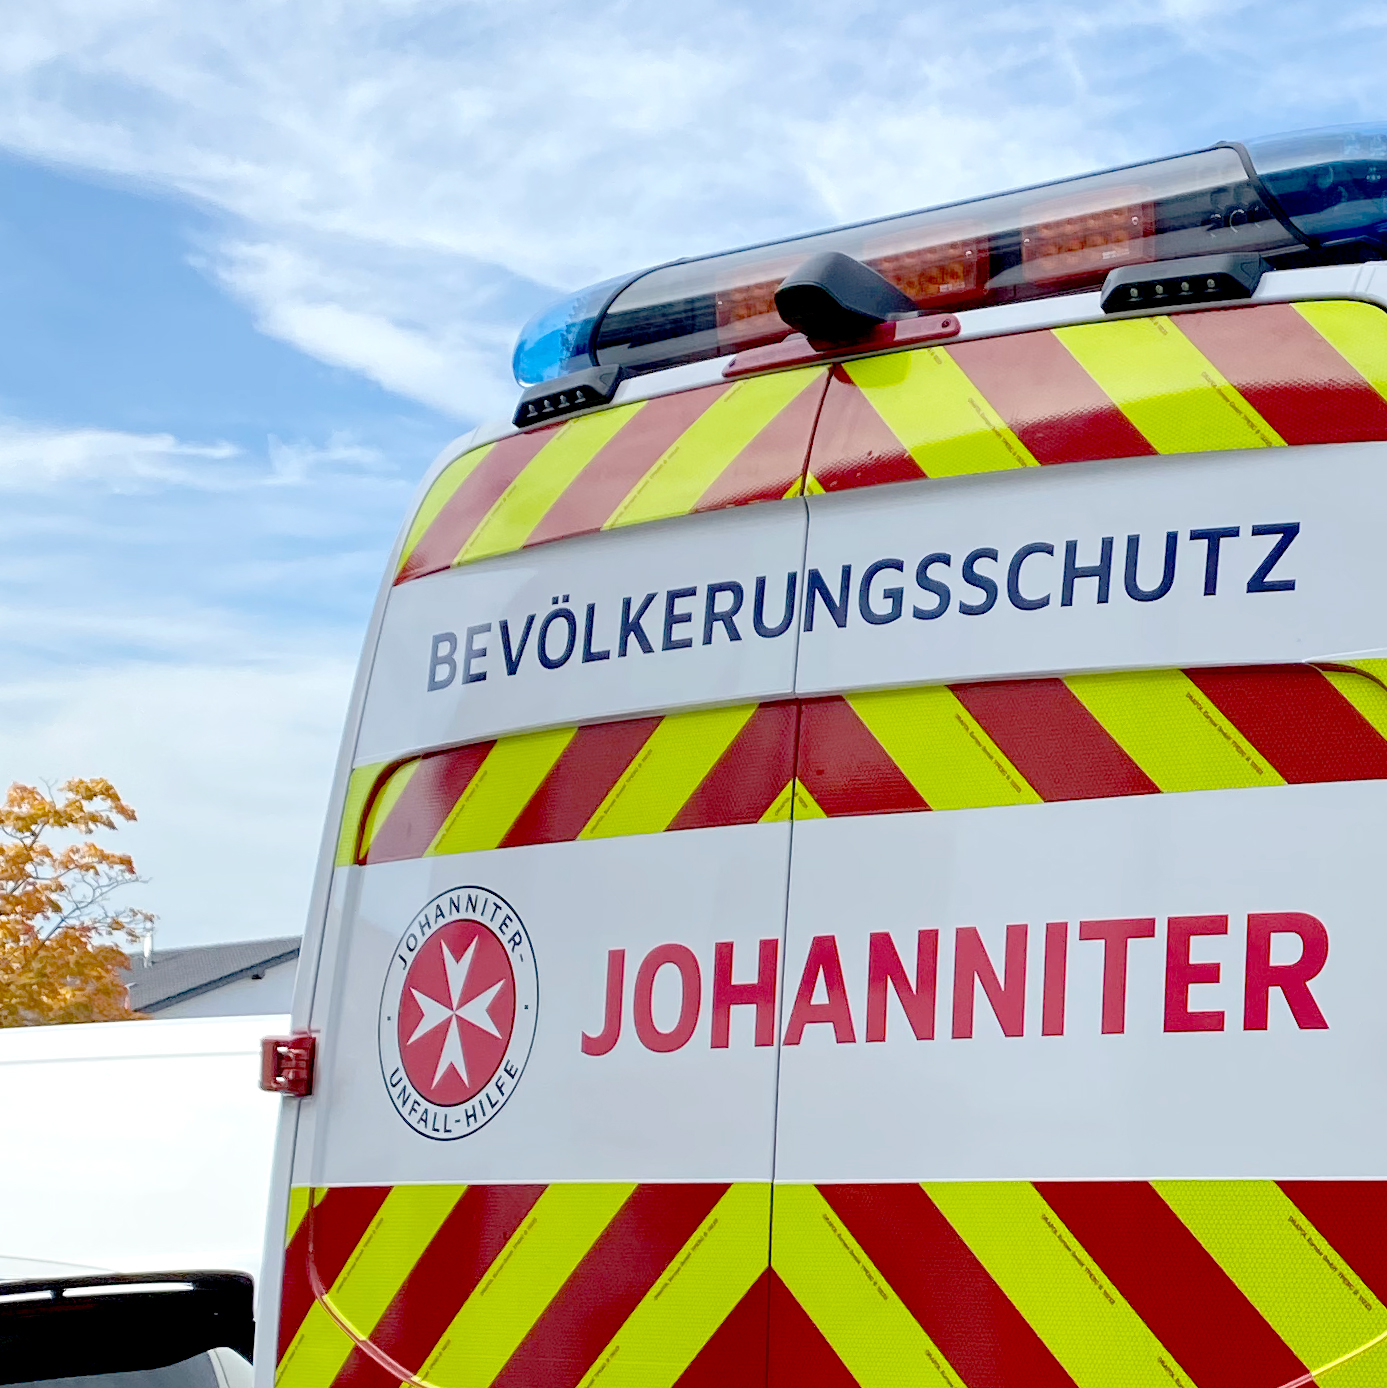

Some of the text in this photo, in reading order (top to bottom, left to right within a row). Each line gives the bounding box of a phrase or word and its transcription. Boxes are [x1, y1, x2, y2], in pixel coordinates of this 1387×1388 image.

[426, 521, 1301, 693] BEVÖLKERUNGSSCHUTZ
[580, 910, 1330, 1058] JOHANNITER
[389, 1057, 519, 1134] UNFALL-HILFE
